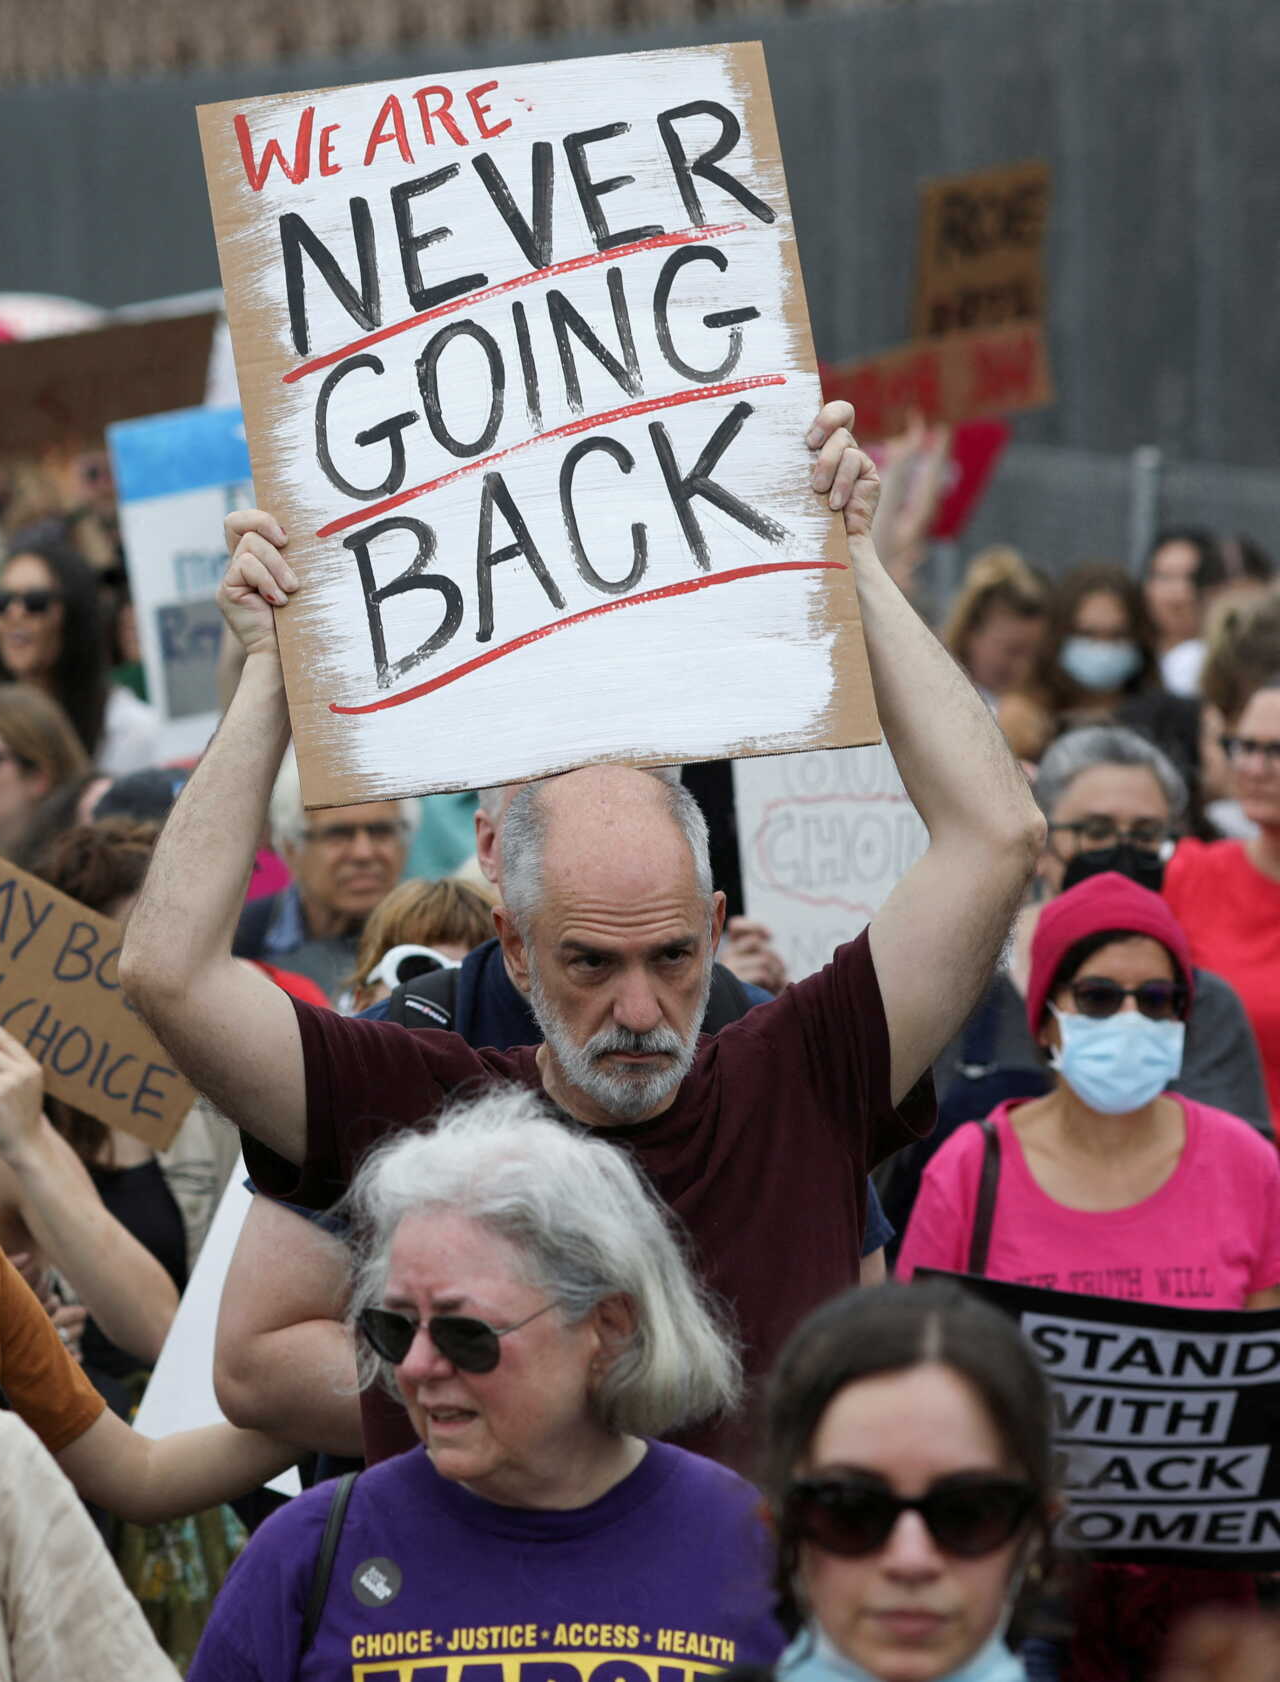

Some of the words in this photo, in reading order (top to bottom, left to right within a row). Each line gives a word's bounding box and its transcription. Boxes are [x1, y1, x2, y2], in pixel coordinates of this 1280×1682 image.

[233, 105, 342, 192] WE
[363, 80, 512, 166] ARE
[279, 100, 776, 356] NEVER
[315, 245, 761, 502] GOING
[343, 401, 789, 690] BACK
[781, 748, 890, 796] OU
[750, 811, 918, 889] CHOI
[52, 921, 130, 1004] BO
[1031, 1325, 1280, 1378] STAND
[1070, 1507, 1280, 1545] OMEN
[351, 1628, 433, 1659] CHOICE
[446, 1623, 538, 1652] JUSTICE
[553, 1622, 640, 1648] ACCESS
[657, 1627, 735, 1664] HEALTH
